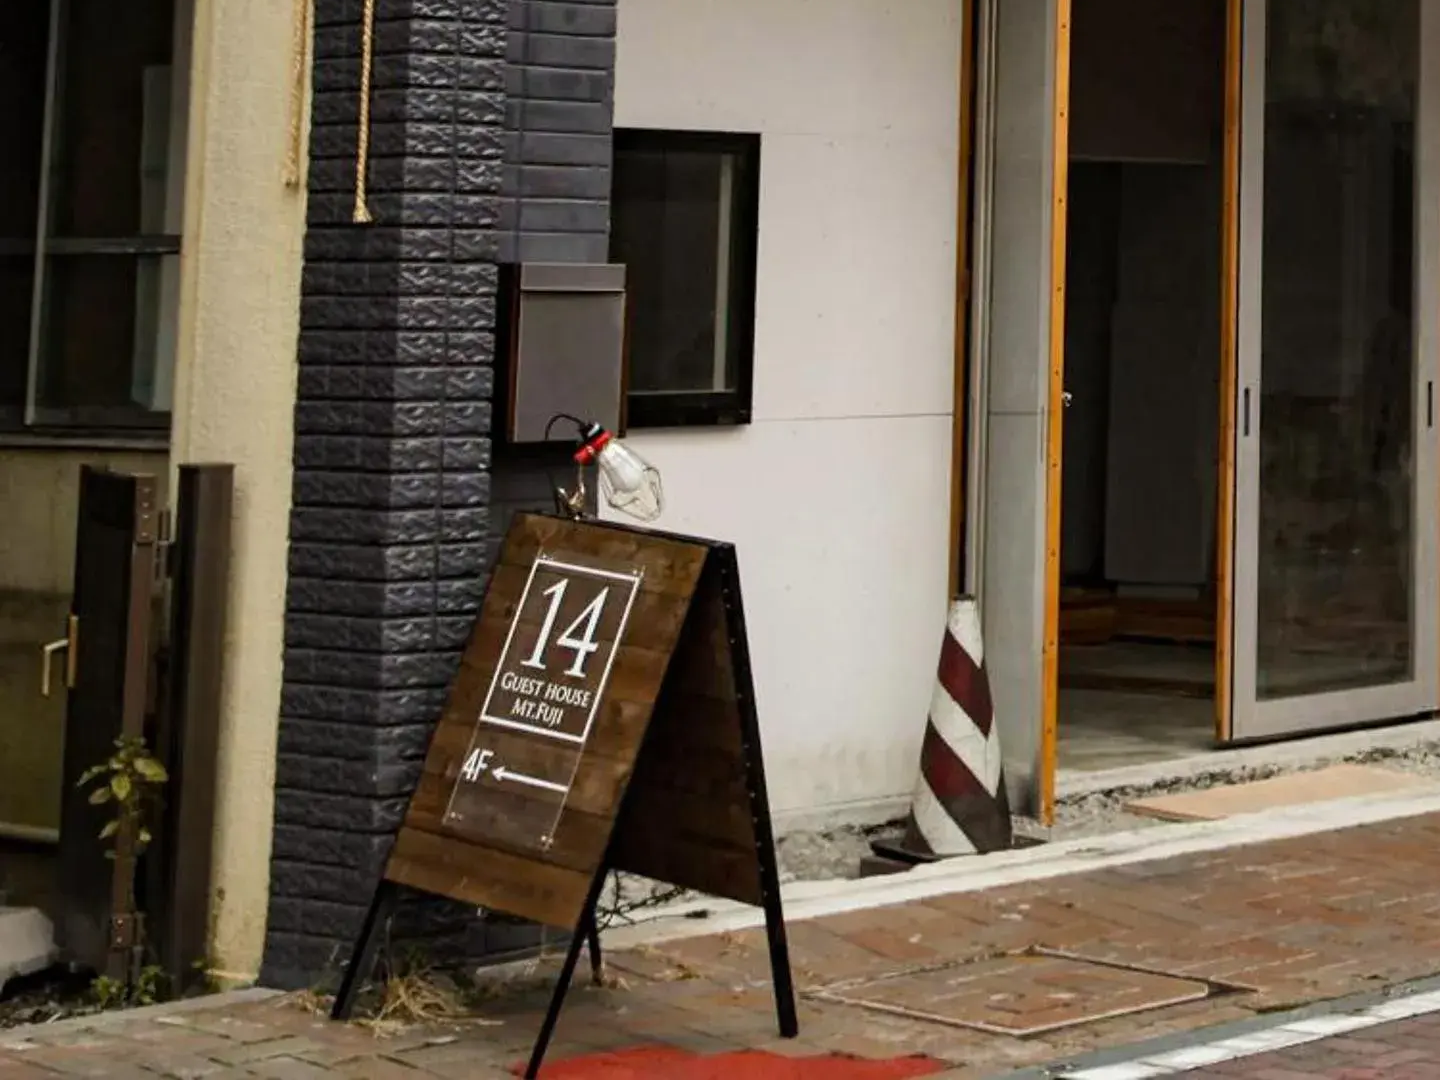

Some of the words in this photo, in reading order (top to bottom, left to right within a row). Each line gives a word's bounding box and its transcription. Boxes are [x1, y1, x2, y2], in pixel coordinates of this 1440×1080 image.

[519, 577, 610, 678] 14
[501, 671, 545, 697] GUEST
[544, 682, 592, 709] HOUSE
[511, 698, 564, 726] MT.FUJI
[462, 748, 494, 782] 4F
